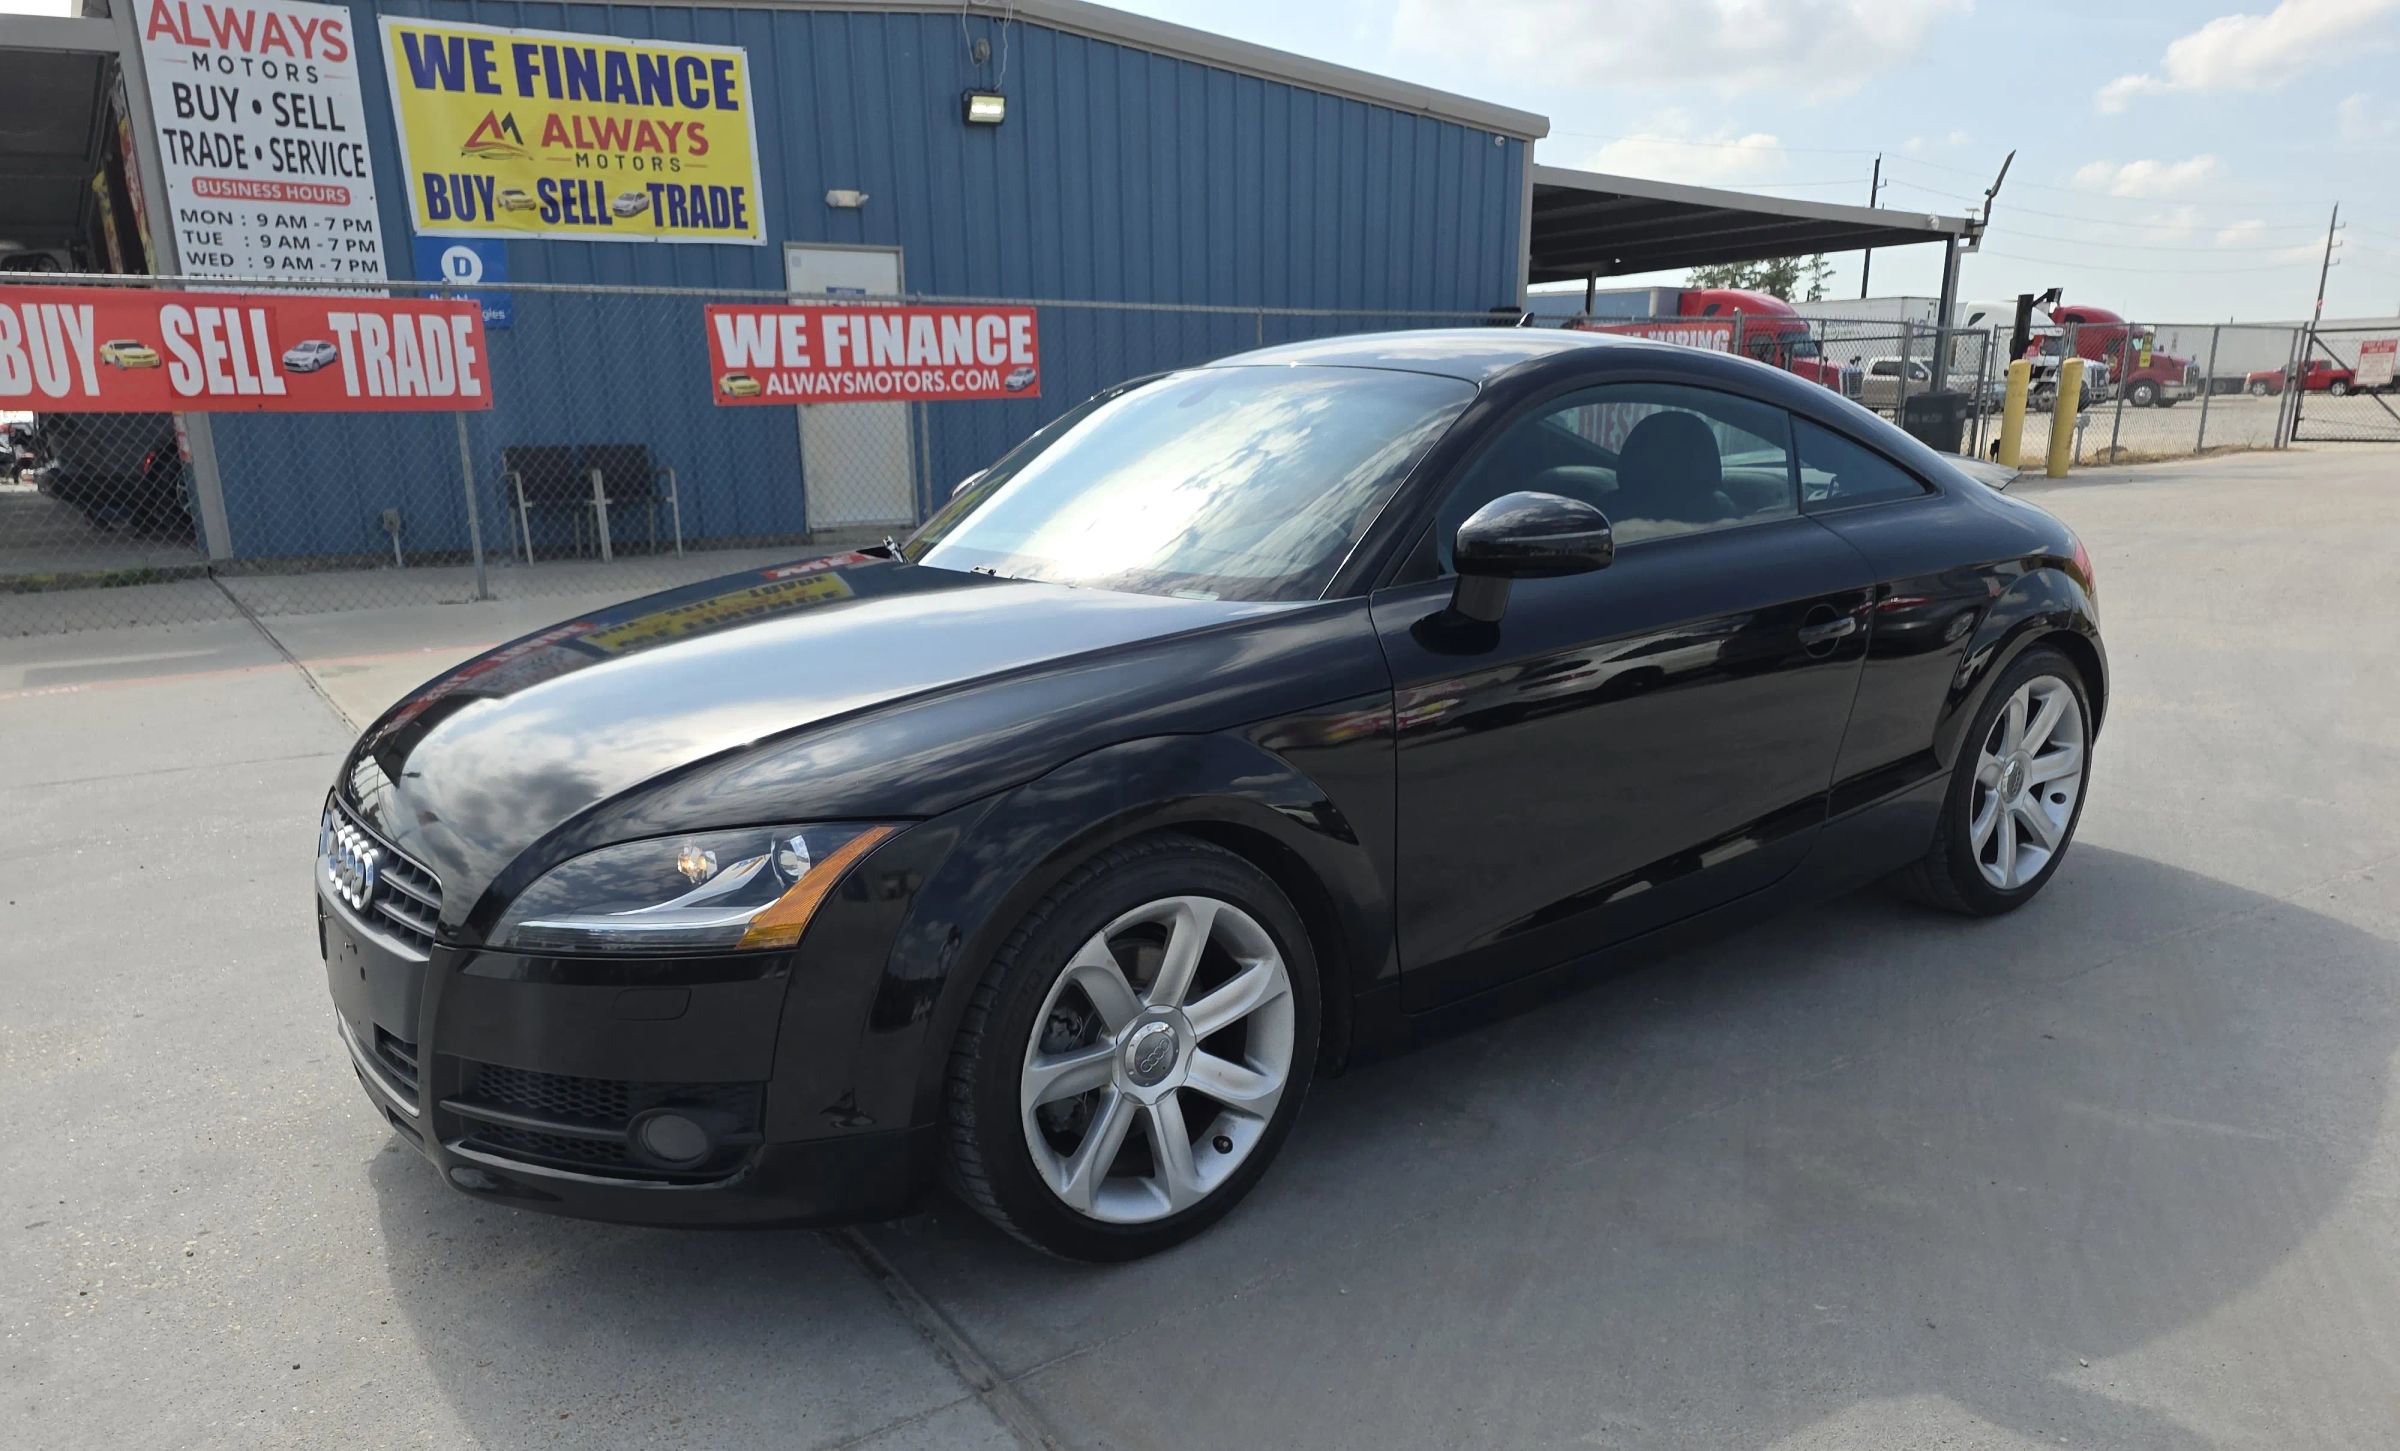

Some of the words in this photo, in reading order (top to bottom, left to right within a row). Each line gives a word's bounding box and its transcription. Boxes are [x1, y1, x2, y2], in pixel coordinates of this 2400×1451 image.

[147, 0, 348, 62] ALWAYS
[192, 52, 318, 84] MOTORS
[400, 32, 502, 95] WE
[512, 43, 739, 111] FINANCE
[172, 82, 239, 123] BUY
[272, 91, 346, 132] SELL
[162, 128, 248, 170] TRADE
[269, 137, 366, 178] SERVICE
[541, 113, 709, 156] ALWAYS
[576, 153, 681, 173] MOTORS
[196, 179, 281, 199] BUSINESS
[286, 186, 346, 203] HOURS
[422, 173, 495, 222] BUY
[537, 177, 613, 226] SELL
[646, 183, 749, 230] TRADE
[180, 208, 234, 226] MON
[256, 213, 268, 228] 9
[275, 214, 307, 230] AM
[324, 217, 336, 231] 7
[343, 218, 374, 234] PM
[183, 230, 224, 246] TUE
[260, 234, 272, 249] 9
[278, 235, 311, 251] AM
[327, 238, 339, 252] 7
[346, 239, 376, 254] PM
[186, 251, 235, 267] WED
[263, 255, 275, 270] 9
[281, 256, 314, 271] AM
[330, 258, 342, 272] 7
[349, 260, 379, 274] PM
[0, 303, 100, 398] BUY
[159, 304, 287, 397] SELL
[327, 312, 481, 397] TRADE
[714, 314, 811, 369] WE
[821, 314, 1034, 368] FINANCE
[766, 369, 1000, 396] ALWAYSMOTORS.COM
